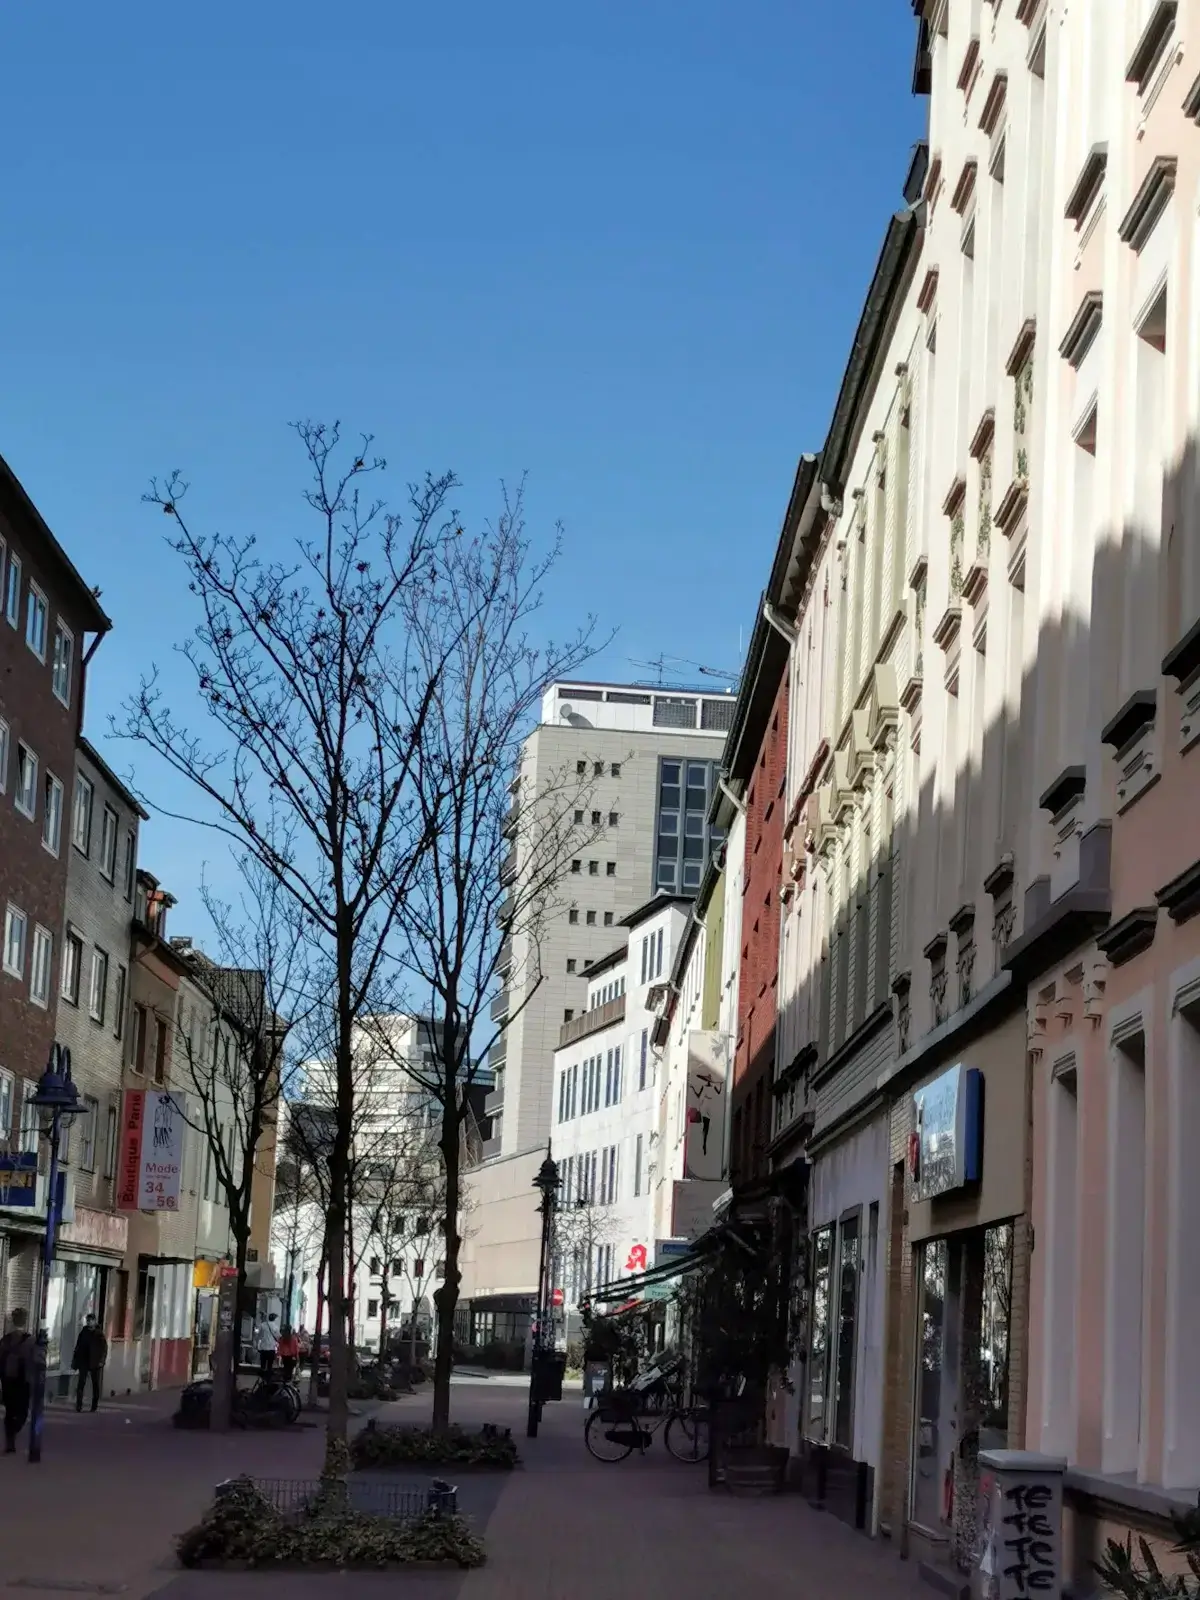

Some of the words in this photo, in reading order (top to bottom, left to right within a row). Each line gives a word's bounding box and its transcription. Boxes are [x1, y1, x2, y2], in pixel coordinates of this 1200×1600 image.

[122, 1138, 140, 1202] Boutique
[145, 1163, 179, 1174] Mode
[145, 1182, 164, 1194] 34
[156, 1196, 175, 1208] 56
